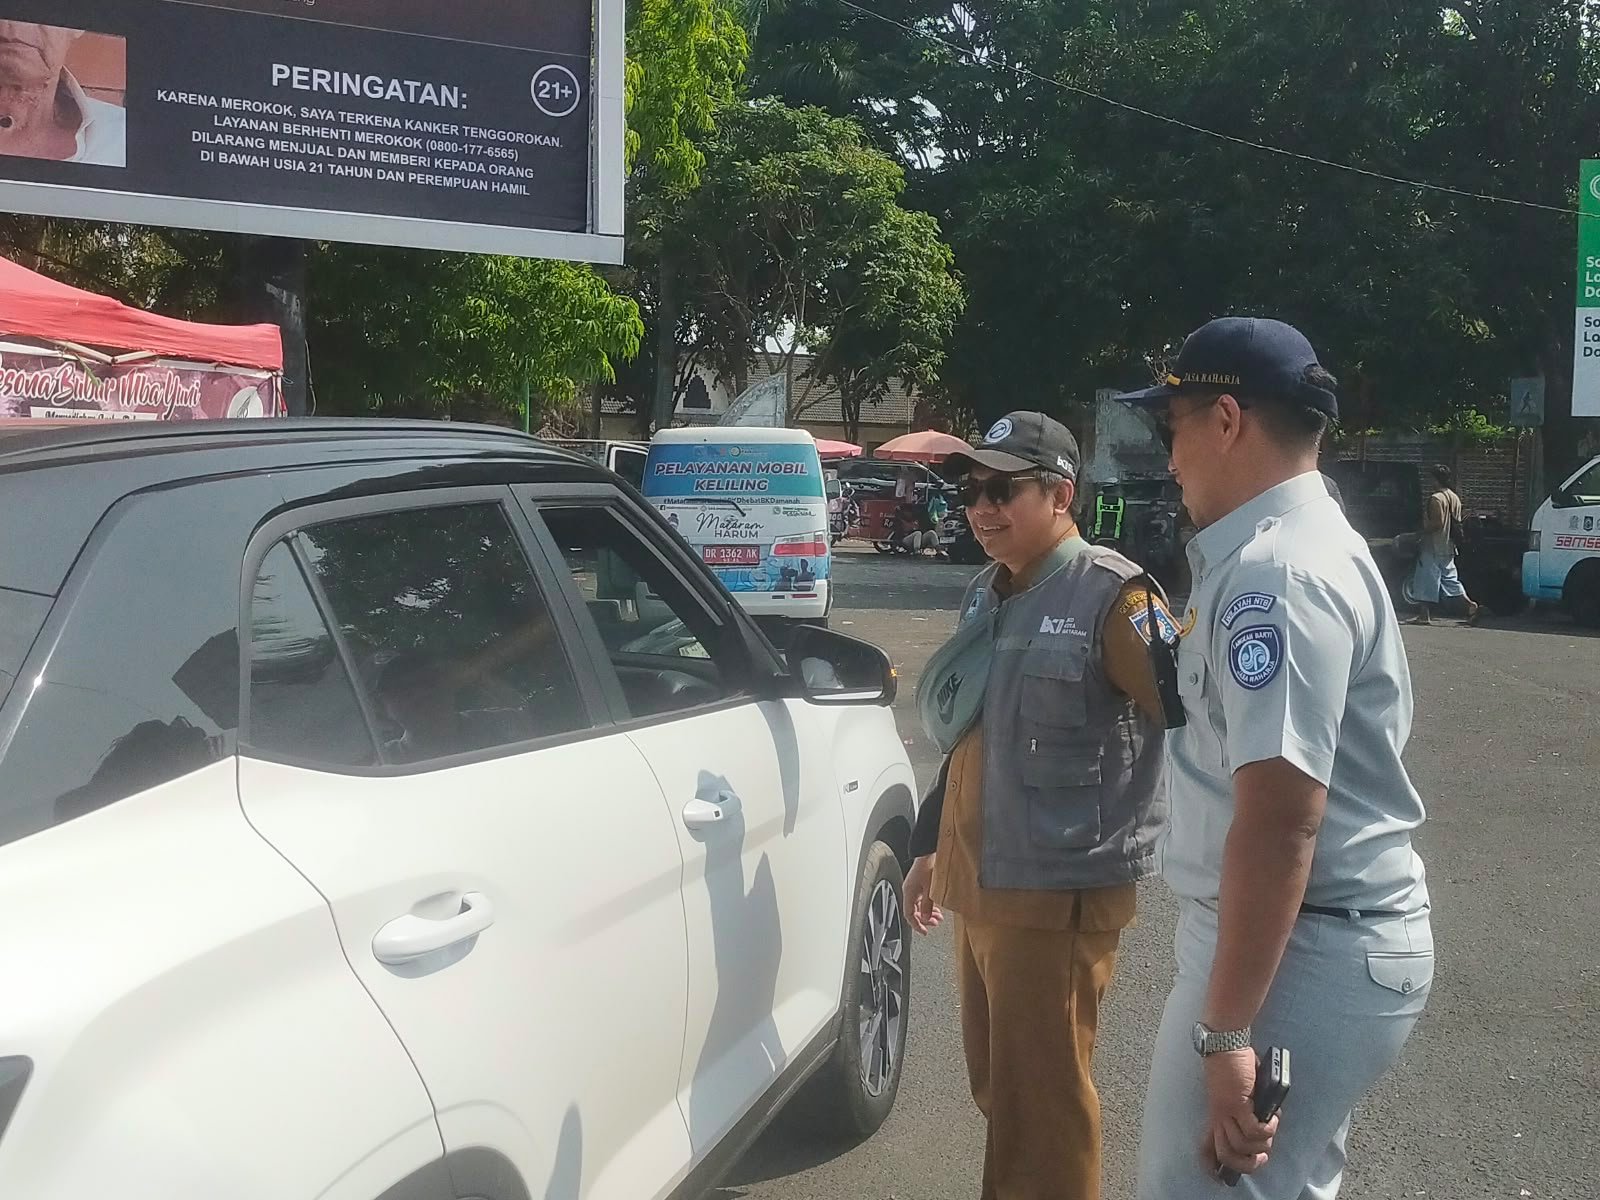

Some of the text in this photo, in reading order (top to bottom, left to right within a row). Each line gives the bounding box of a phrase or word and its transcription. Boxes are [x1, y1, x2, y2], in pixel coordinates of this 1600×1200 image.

[272, 63, 467, 110] PERINGATAN:
[538, 80, 573, 100] 21+
[157, 90, 563, 148] KARENA MEROKOK, SAYA TERKENA KANKER TENGGOROKAN.
[214, 115, 519, 162] LAYANAN BERHENTI MEROKOK (0800-177-6565)
[192, 130, 534, 179] DILARANG MENJUAL DAN MEMBERI KEPADA ORANG
[200, 150, 530, 196] DI BAWAH USIA 21 TAHUN DAN PEREMPUAN HAMIL
[654, 461, 808, 476] PELAYANAN MOBIL
[694, 478, 769, 492] KELILING
[696, 512, 765, 533] Mataram
[714, 530, 759, 539] HARUM
[705, 548, 758, 558] DR 1362 AK
[1253, 597, 1270, 606] NTB
[936, 671, 959, 712] NIKE
